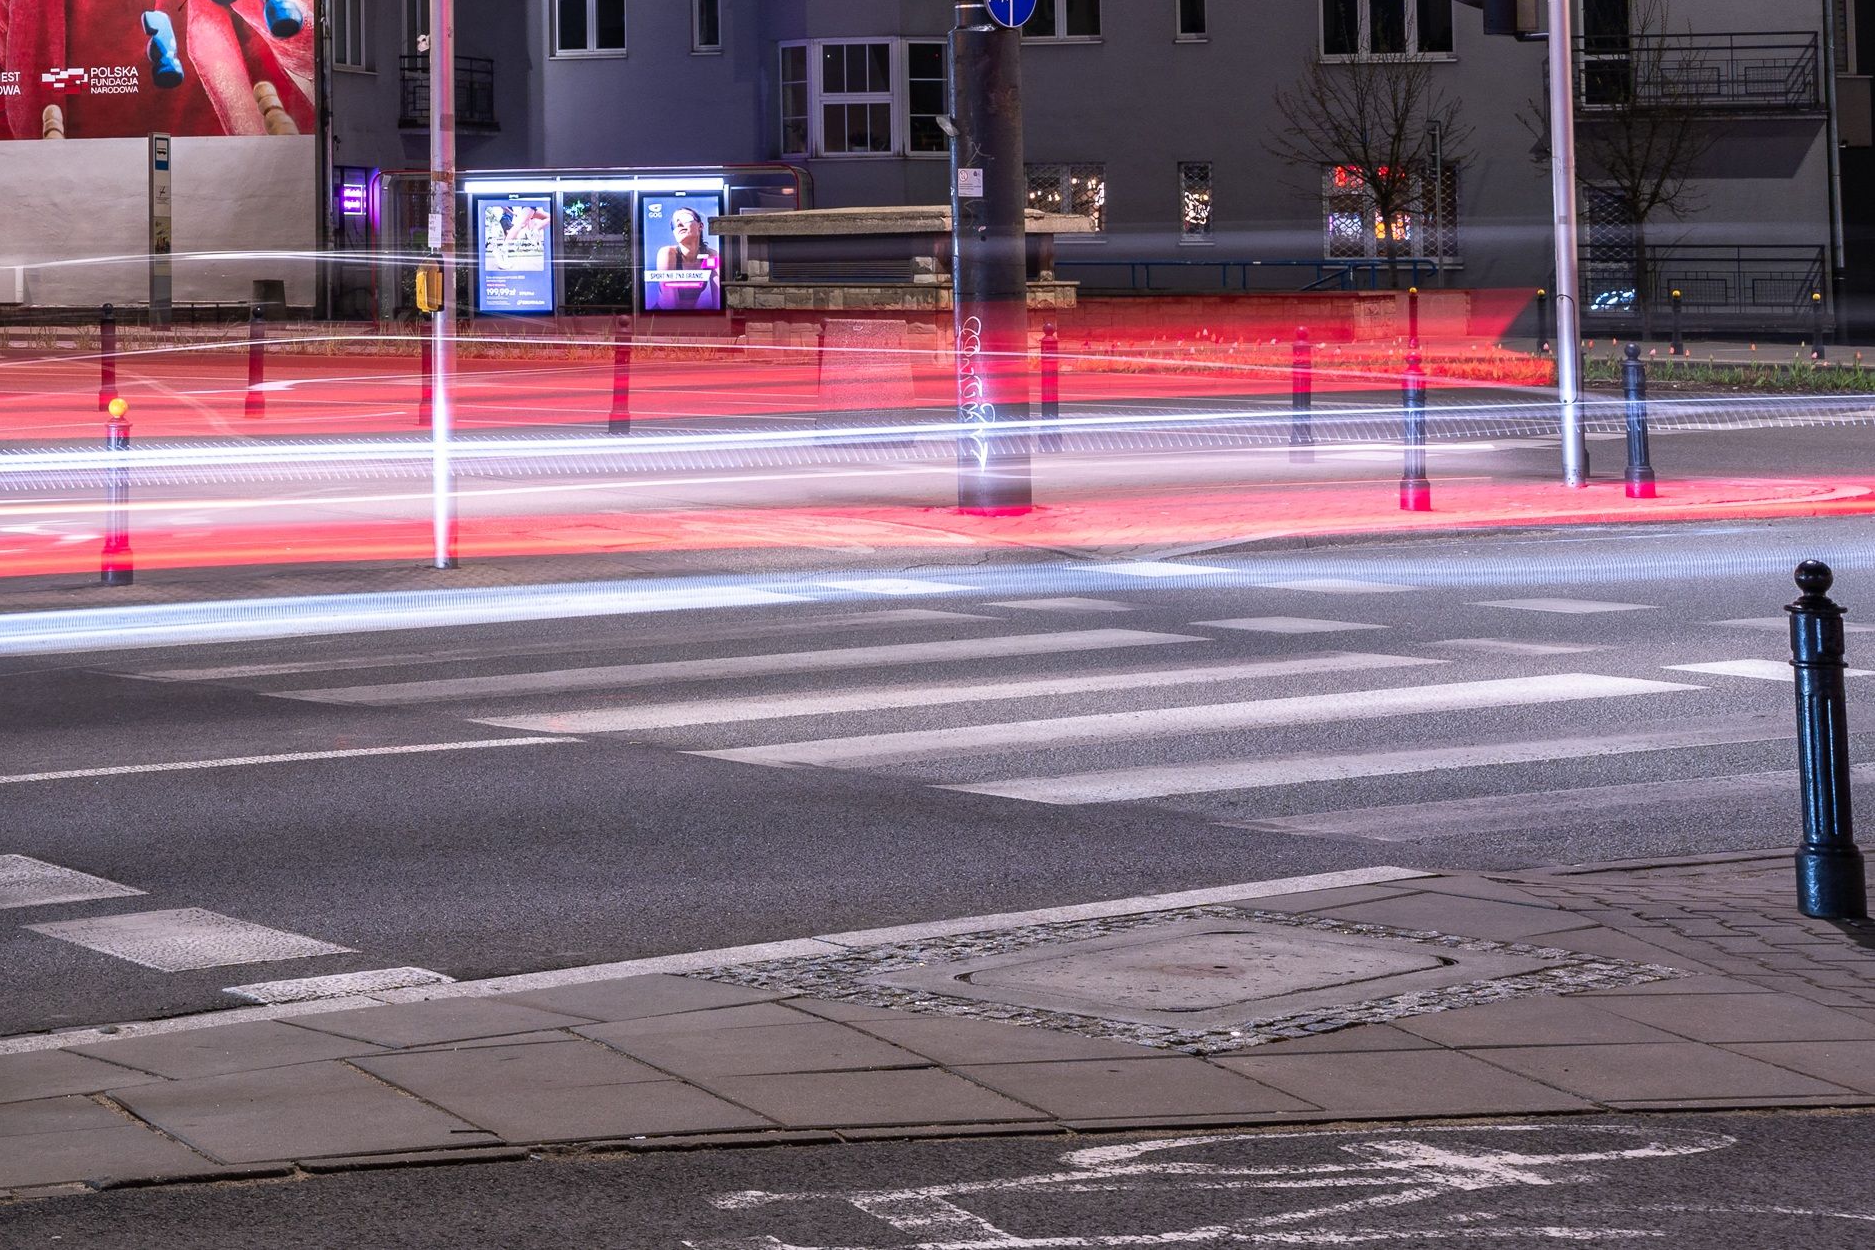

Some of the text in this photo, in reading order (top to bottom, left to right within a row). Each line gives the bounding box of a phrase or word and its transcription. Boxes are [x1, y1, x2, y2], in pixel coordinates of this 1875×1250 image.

[90, 66, 139, 78] POLSKA
[90, 78, 139, 87] FUNDACJA
[90, 86, 139, 95] NARODOWA
